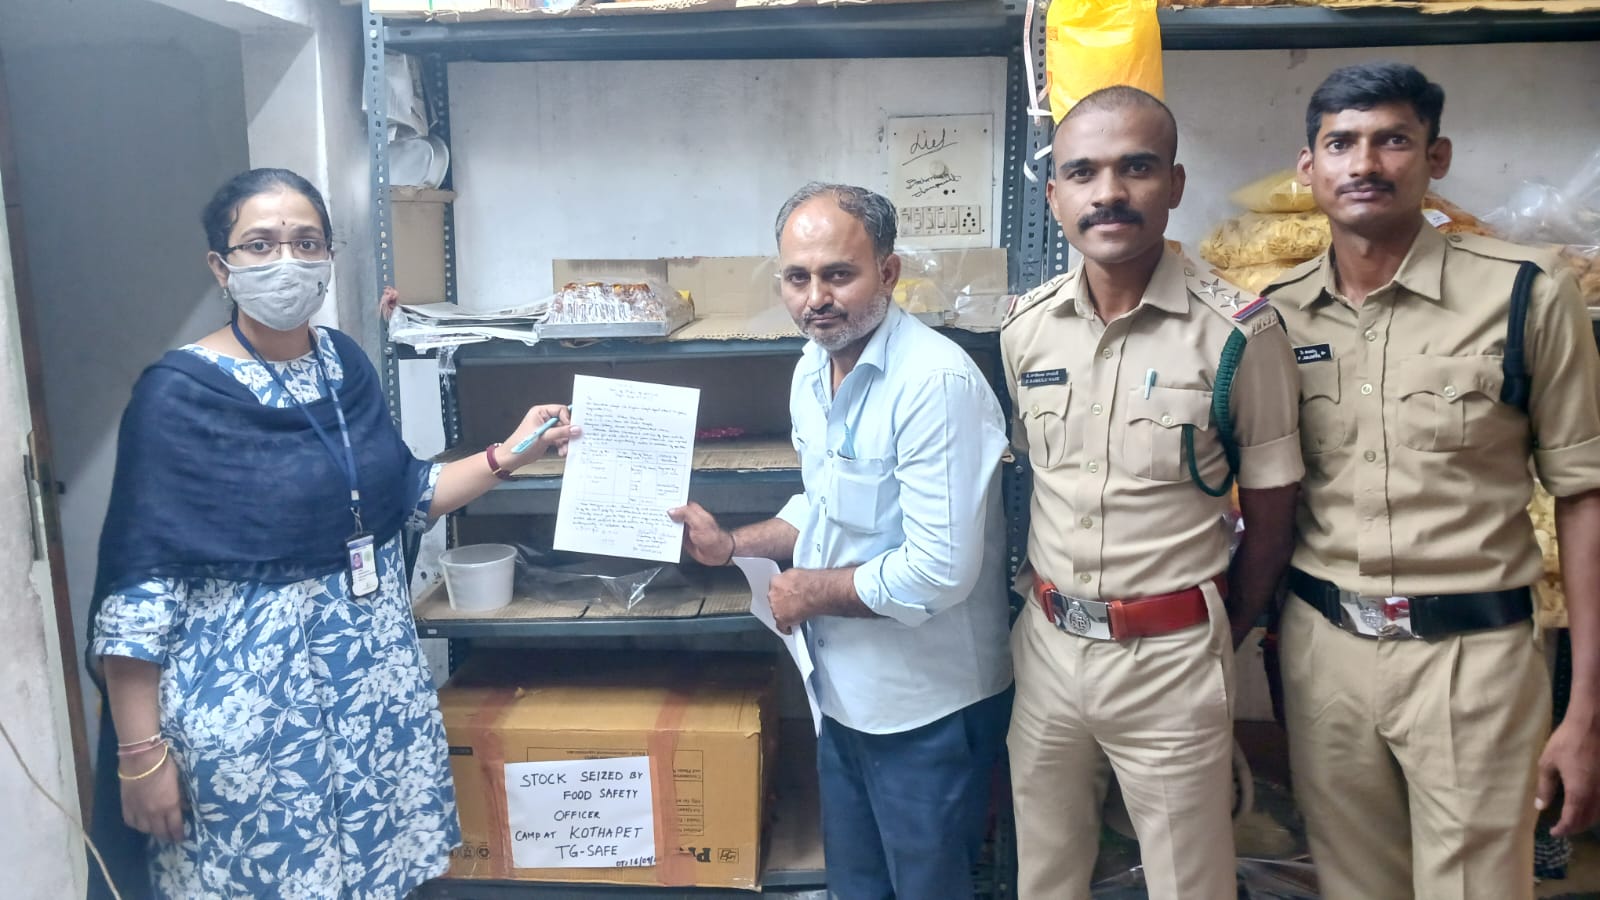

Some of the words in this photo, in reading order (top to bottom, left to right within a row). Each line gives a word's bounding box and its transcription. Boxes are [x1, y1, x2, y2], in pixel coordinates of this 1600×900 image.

[519, 773, 567, 787] STOCK
[580, 771, 623, 782] SEIZED
[629, 771, 643, 779] BY
[563, 790, 592, 800] FOOD
[600, 788, 638, 799] SAFETY
[554, 810, 600, 821] OFFICER
[515, 830, 541, 841] CAMP
[543, 831, 557, 839] AT
[569, 825, 644, 839] KOTHAPET
[555, 844, 618, 859] TG-SAFE
